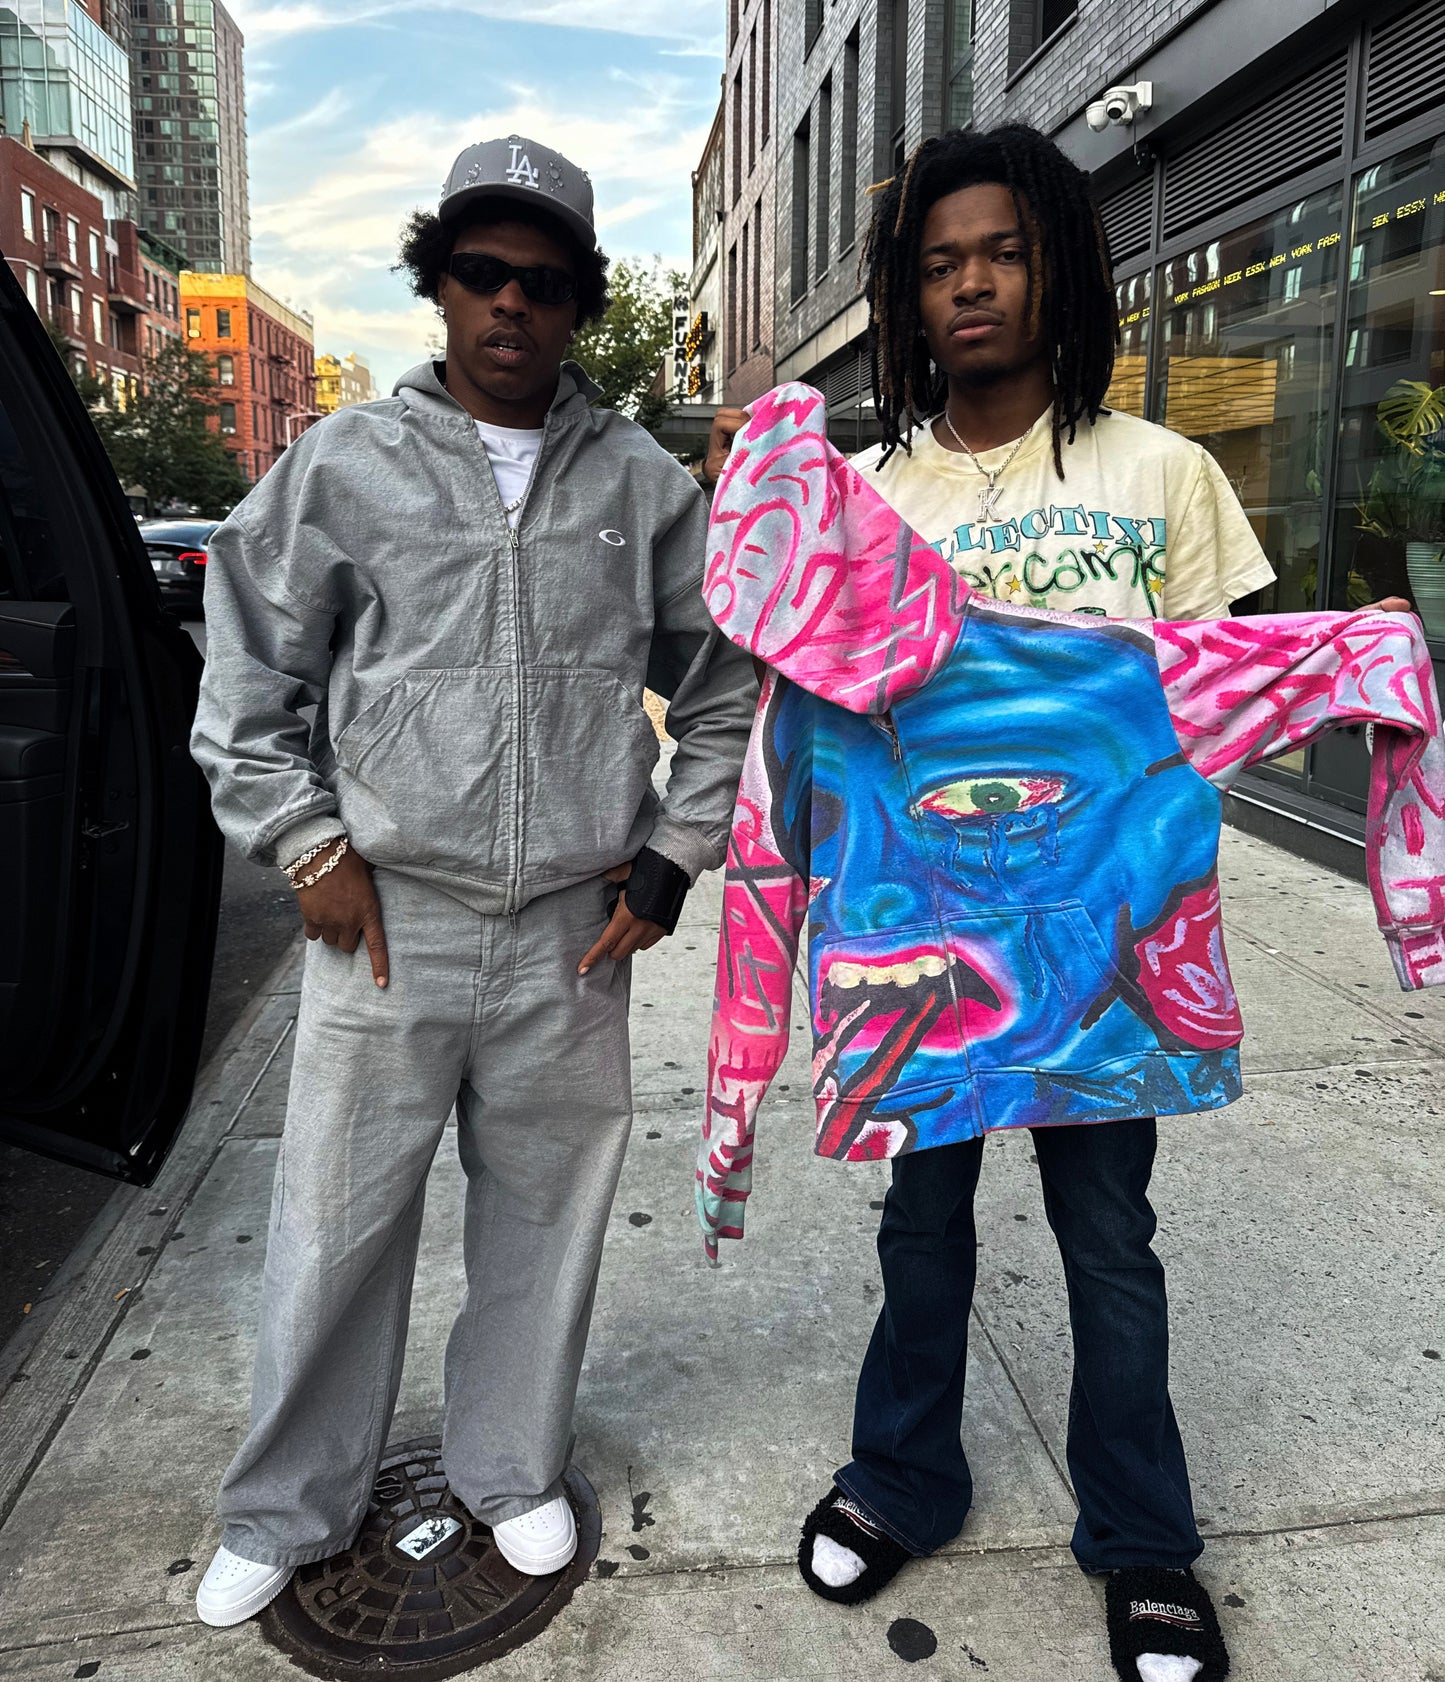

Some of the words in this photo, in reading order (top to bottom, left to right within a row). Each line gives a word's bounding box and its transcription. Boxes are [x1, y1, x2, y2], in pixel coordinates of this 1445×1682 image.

[506, 145, 539, 188] LA
[1396, 198, 1426, 219] ESSX
[1174, 291, 1190, 304] YORK
[1192, 279, 1220, 298] FASHION
[1223, 270, 1242, 286] WEEK
[1245, 261, 1266, 277] ESSX
[1269, 253, 1287, 268] NEW
[1291, 242, 1313, 259] YORK
[1129, 1599, 1199, 1620] Balenciaga
